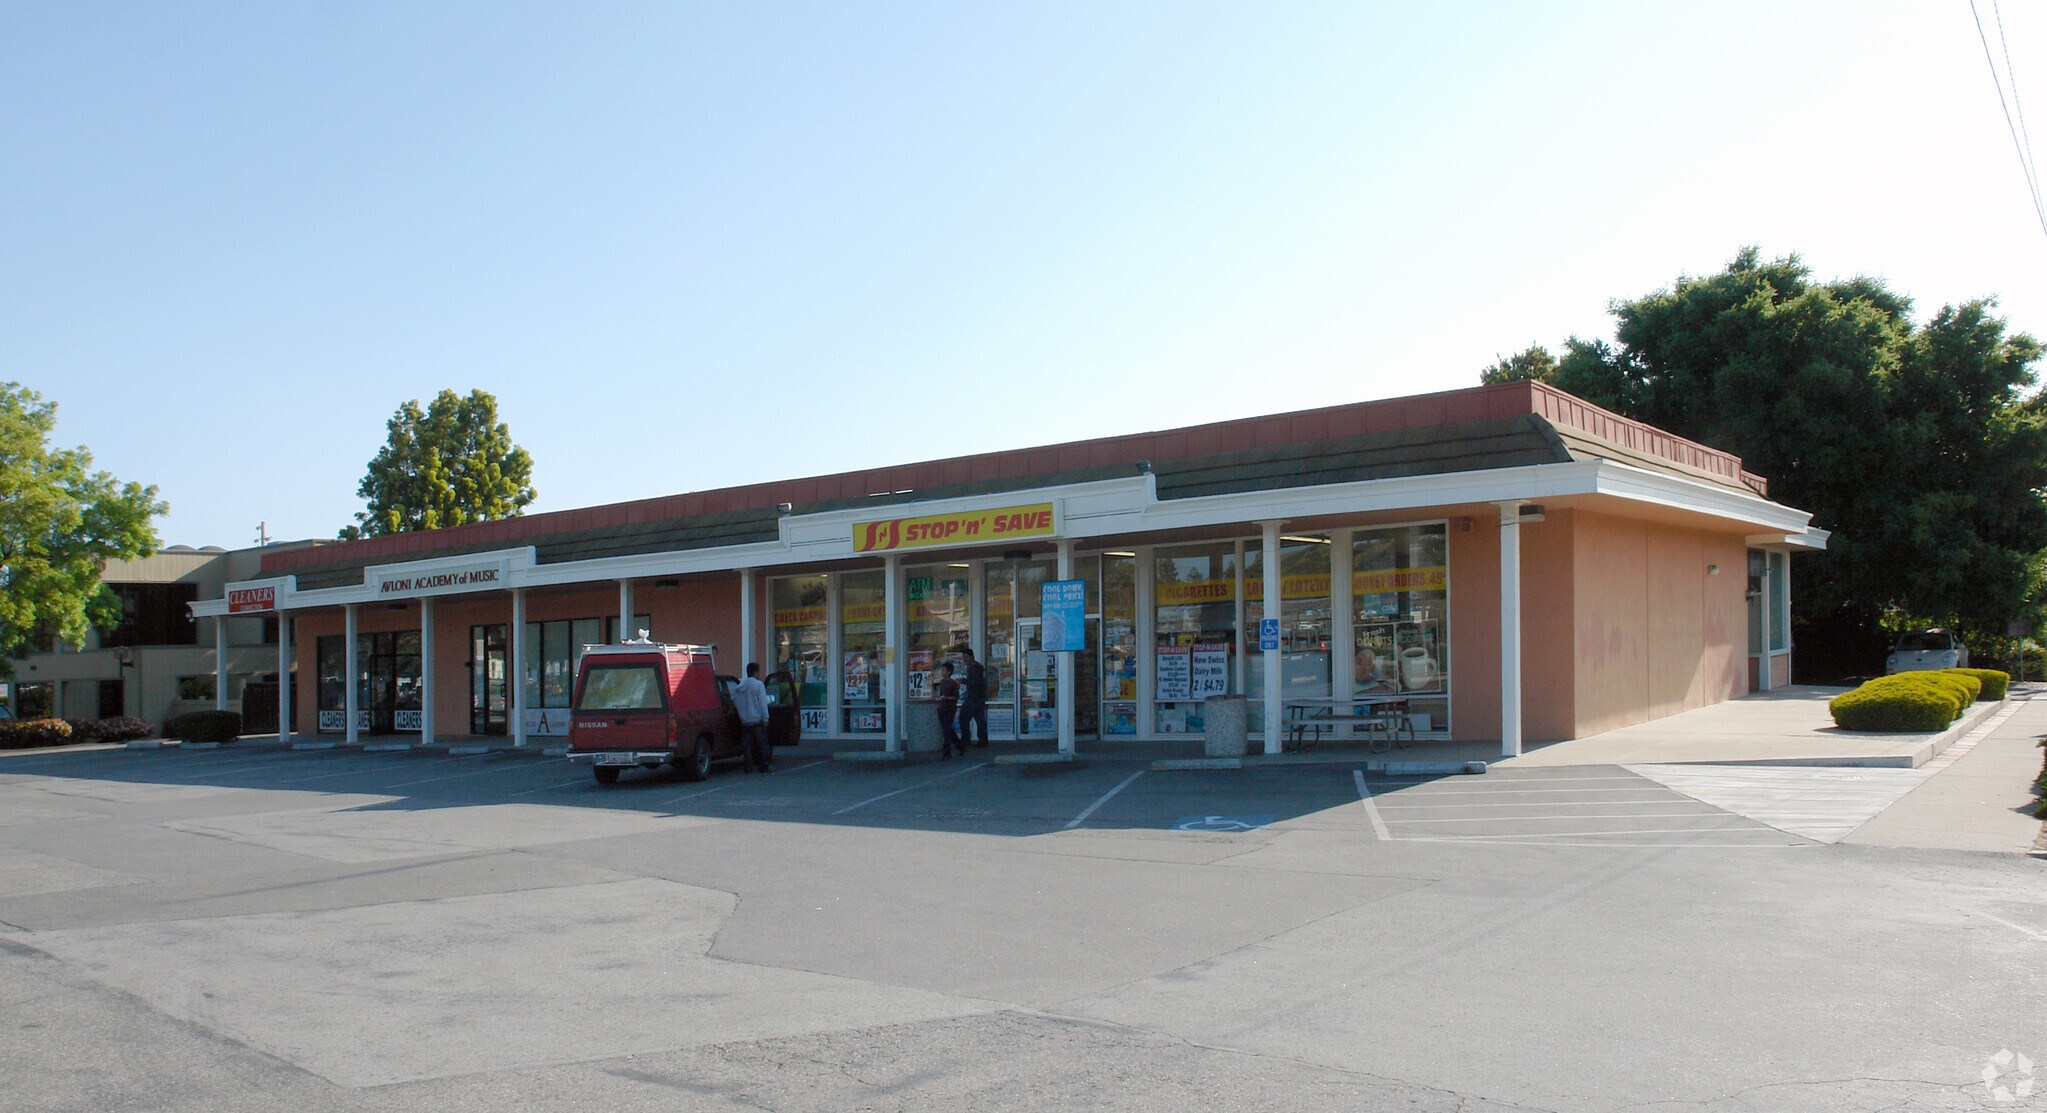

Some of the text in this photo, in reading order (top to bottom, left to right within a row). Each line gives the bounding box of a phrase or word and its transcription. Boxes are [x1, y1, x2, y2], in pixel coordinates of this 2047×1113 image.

[992, 511, 1052, 532] SAVE
[414, 573, 459, 589] ACADEMY
[469, 569, 499, 583] MUSIC
[910, 578, 931, 591] ATM
[1388, 572, 1425, 587] ORDERS
[1043, 585, 1060, 593] COOL
[1166, 583, 1228, 600] CIGARETTES
[1246, 582, 1263, 595] LO
[230, 588, 274, 605] CLEANERS
[1208, 656, 1225, 664] Swiss
[1194, 668, 1209, 677] Dairy
[1204, 680, 1225, 692] $4.79
[321, 712, 344, 728] CLEANERS
[397, 712, 422, 729] CLEANERS
